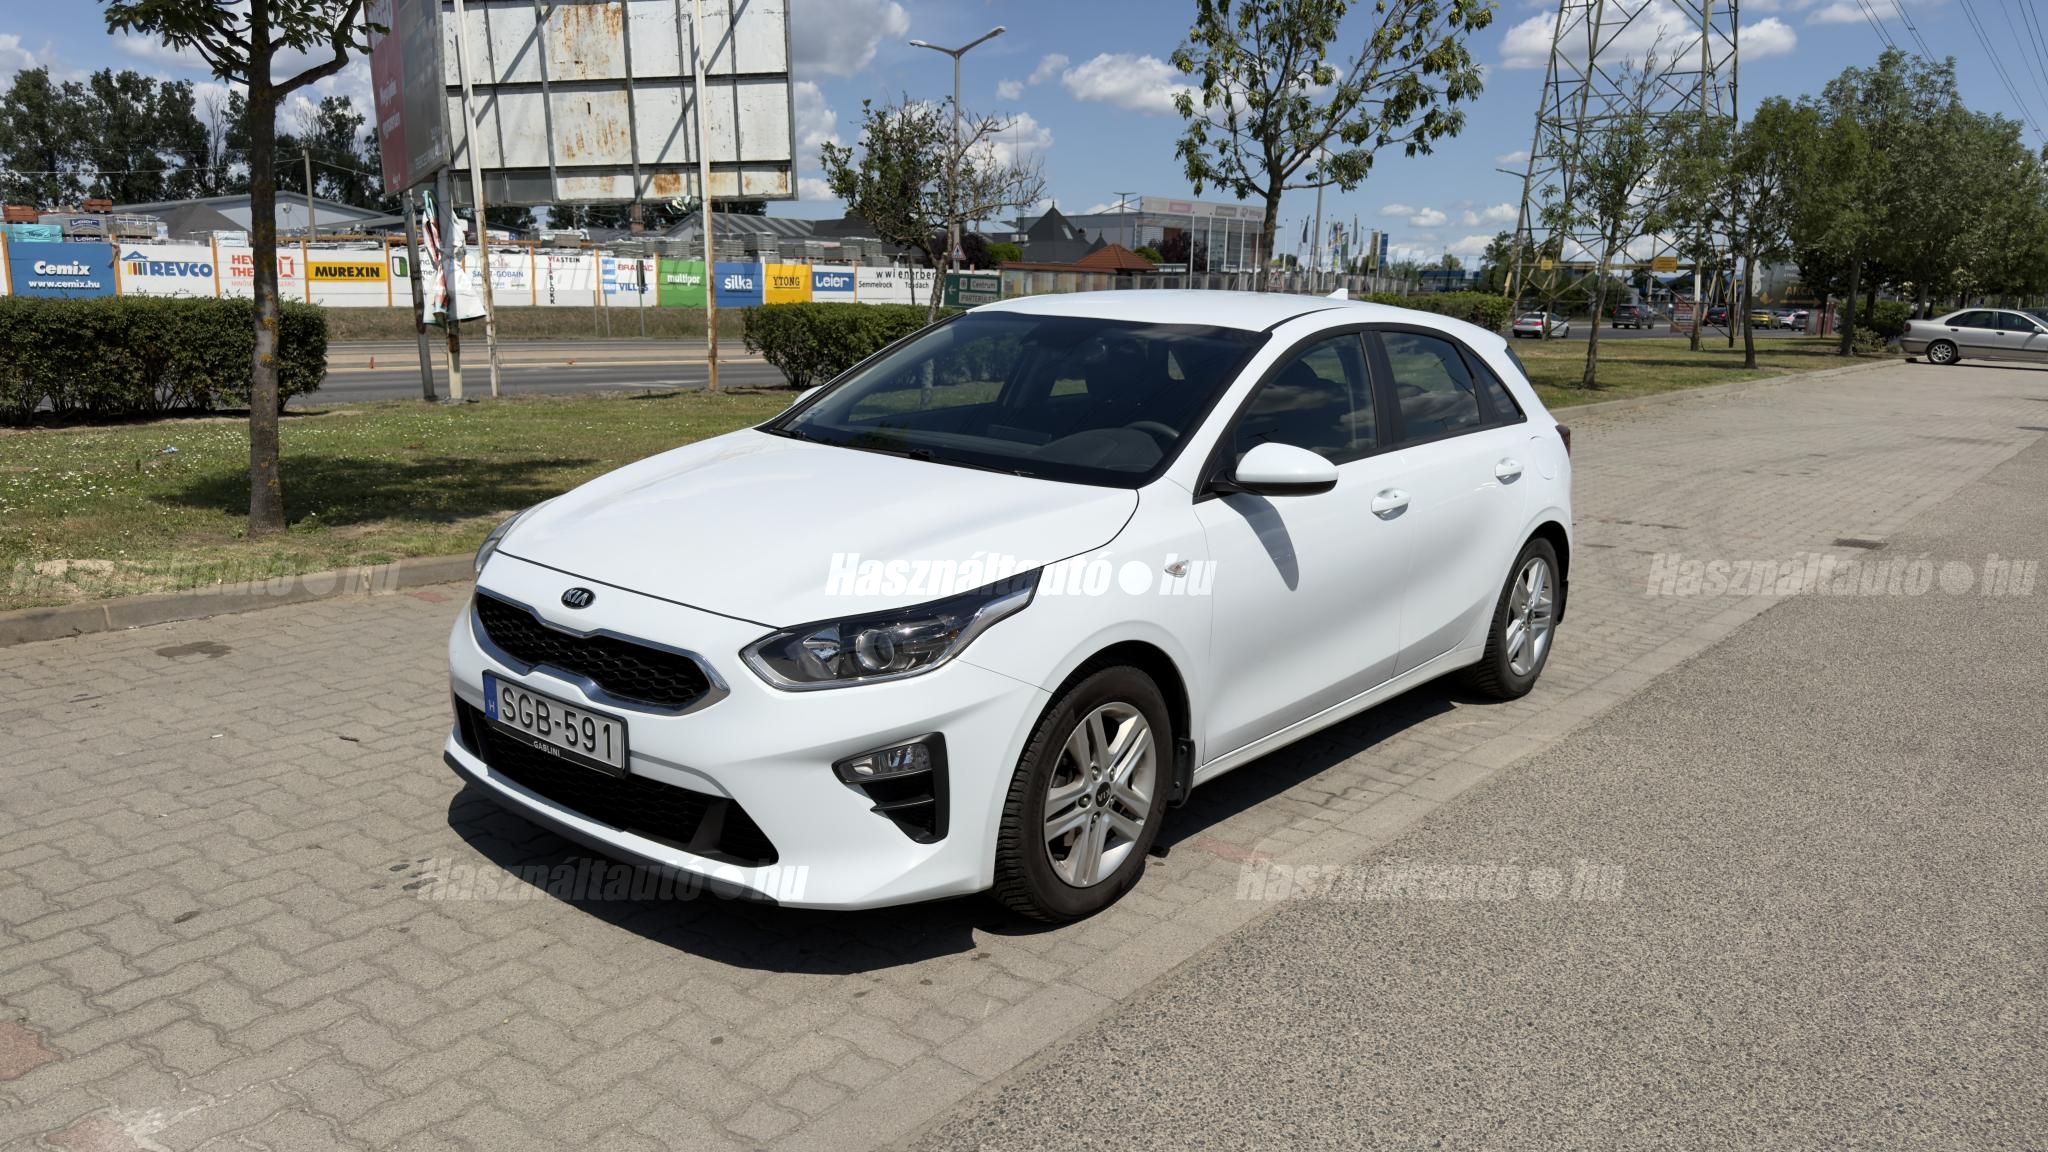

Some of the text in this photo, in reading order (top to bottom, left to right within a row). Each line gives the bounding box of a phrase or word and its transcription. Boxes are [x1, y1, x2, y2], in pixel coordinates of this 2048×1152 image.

[34, 260, 91, 276] Cemix
[149, 261, 213, 278] REVCO
[229, 266, 254, 277] THE
[314, 265, 381, 279] MUREXIN
[472, 270, 524, 278] SAT-GOBAIN
[617, 263, 654, 272] BRAAC
[28, 279, 101, 289] www.cemix.hu
[618, 282, 650, 292] VILLS
[667, 273, 701, 287] multipor
[724, 274, 753, 290] silka
[772, 275, 801, 287] YTONG
[815, 274, 850, 288] Leier
[858, 280, 893, 289] Semmelrock
[562, 588, 588, 607] KIA
[488, 687, 613, 761] H SGB-591
[533, 740, 561, 758] GABLINI
